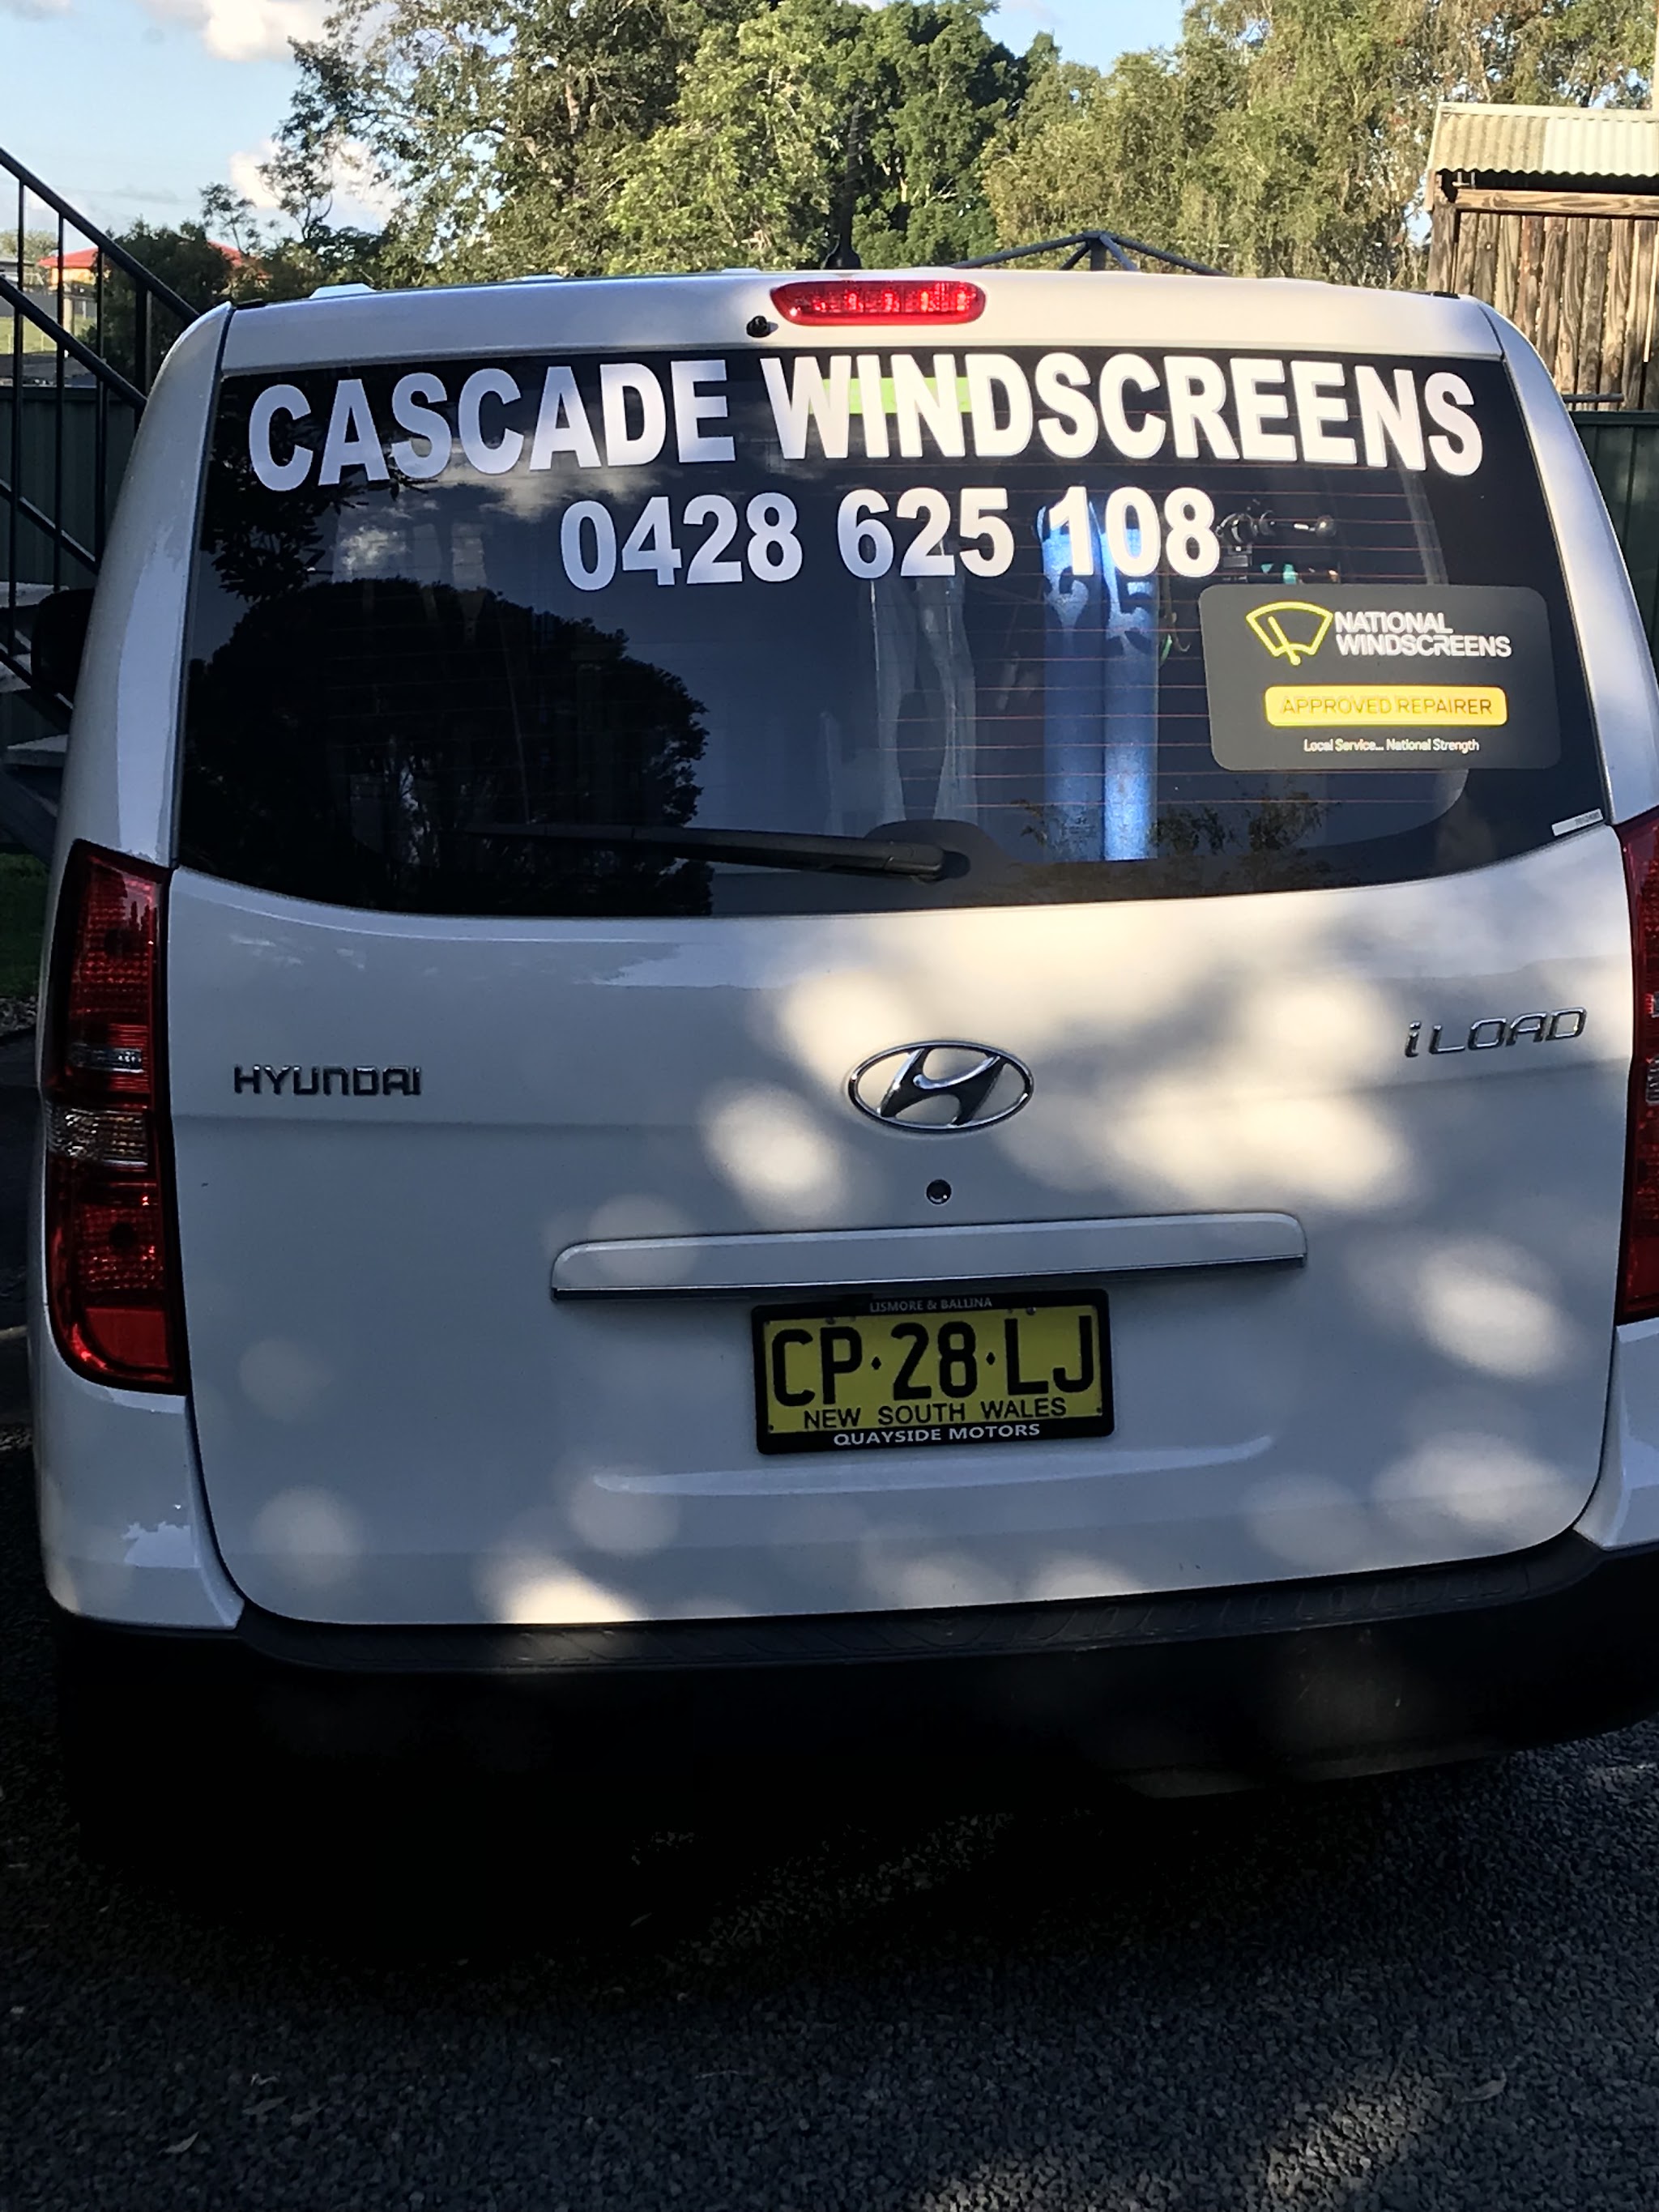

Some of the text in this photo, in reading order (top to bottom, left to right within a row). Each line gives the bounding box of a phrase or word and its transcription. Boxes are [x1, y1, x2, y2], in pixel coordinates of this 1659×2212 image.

[249, 352, 1484, 491] CASCADE WINDSCREENS
[560, 485, 1221, 591] 0428 625 108
[1334, 611, 1454, 634] NATIONAL
[1335, 633, 1513, 658] WINDSCREENS
[1281, 694, 1493, 716] APPROVED REPAIRER
[1303, 738, 1334, 752] Local
[1386, 738, 1431, 752] National
[1432, 738, 1480, 754] Strength
[233, 1065, 422, 1096] HYUNDAI
[869, 1297, 993, 1313] LISMORE & BALLINA
[804, 1396, 1067, 1430] NEW SOUTH WALES
[833, 1422, 1041, 1447] QUAYSIDE MOTORS
